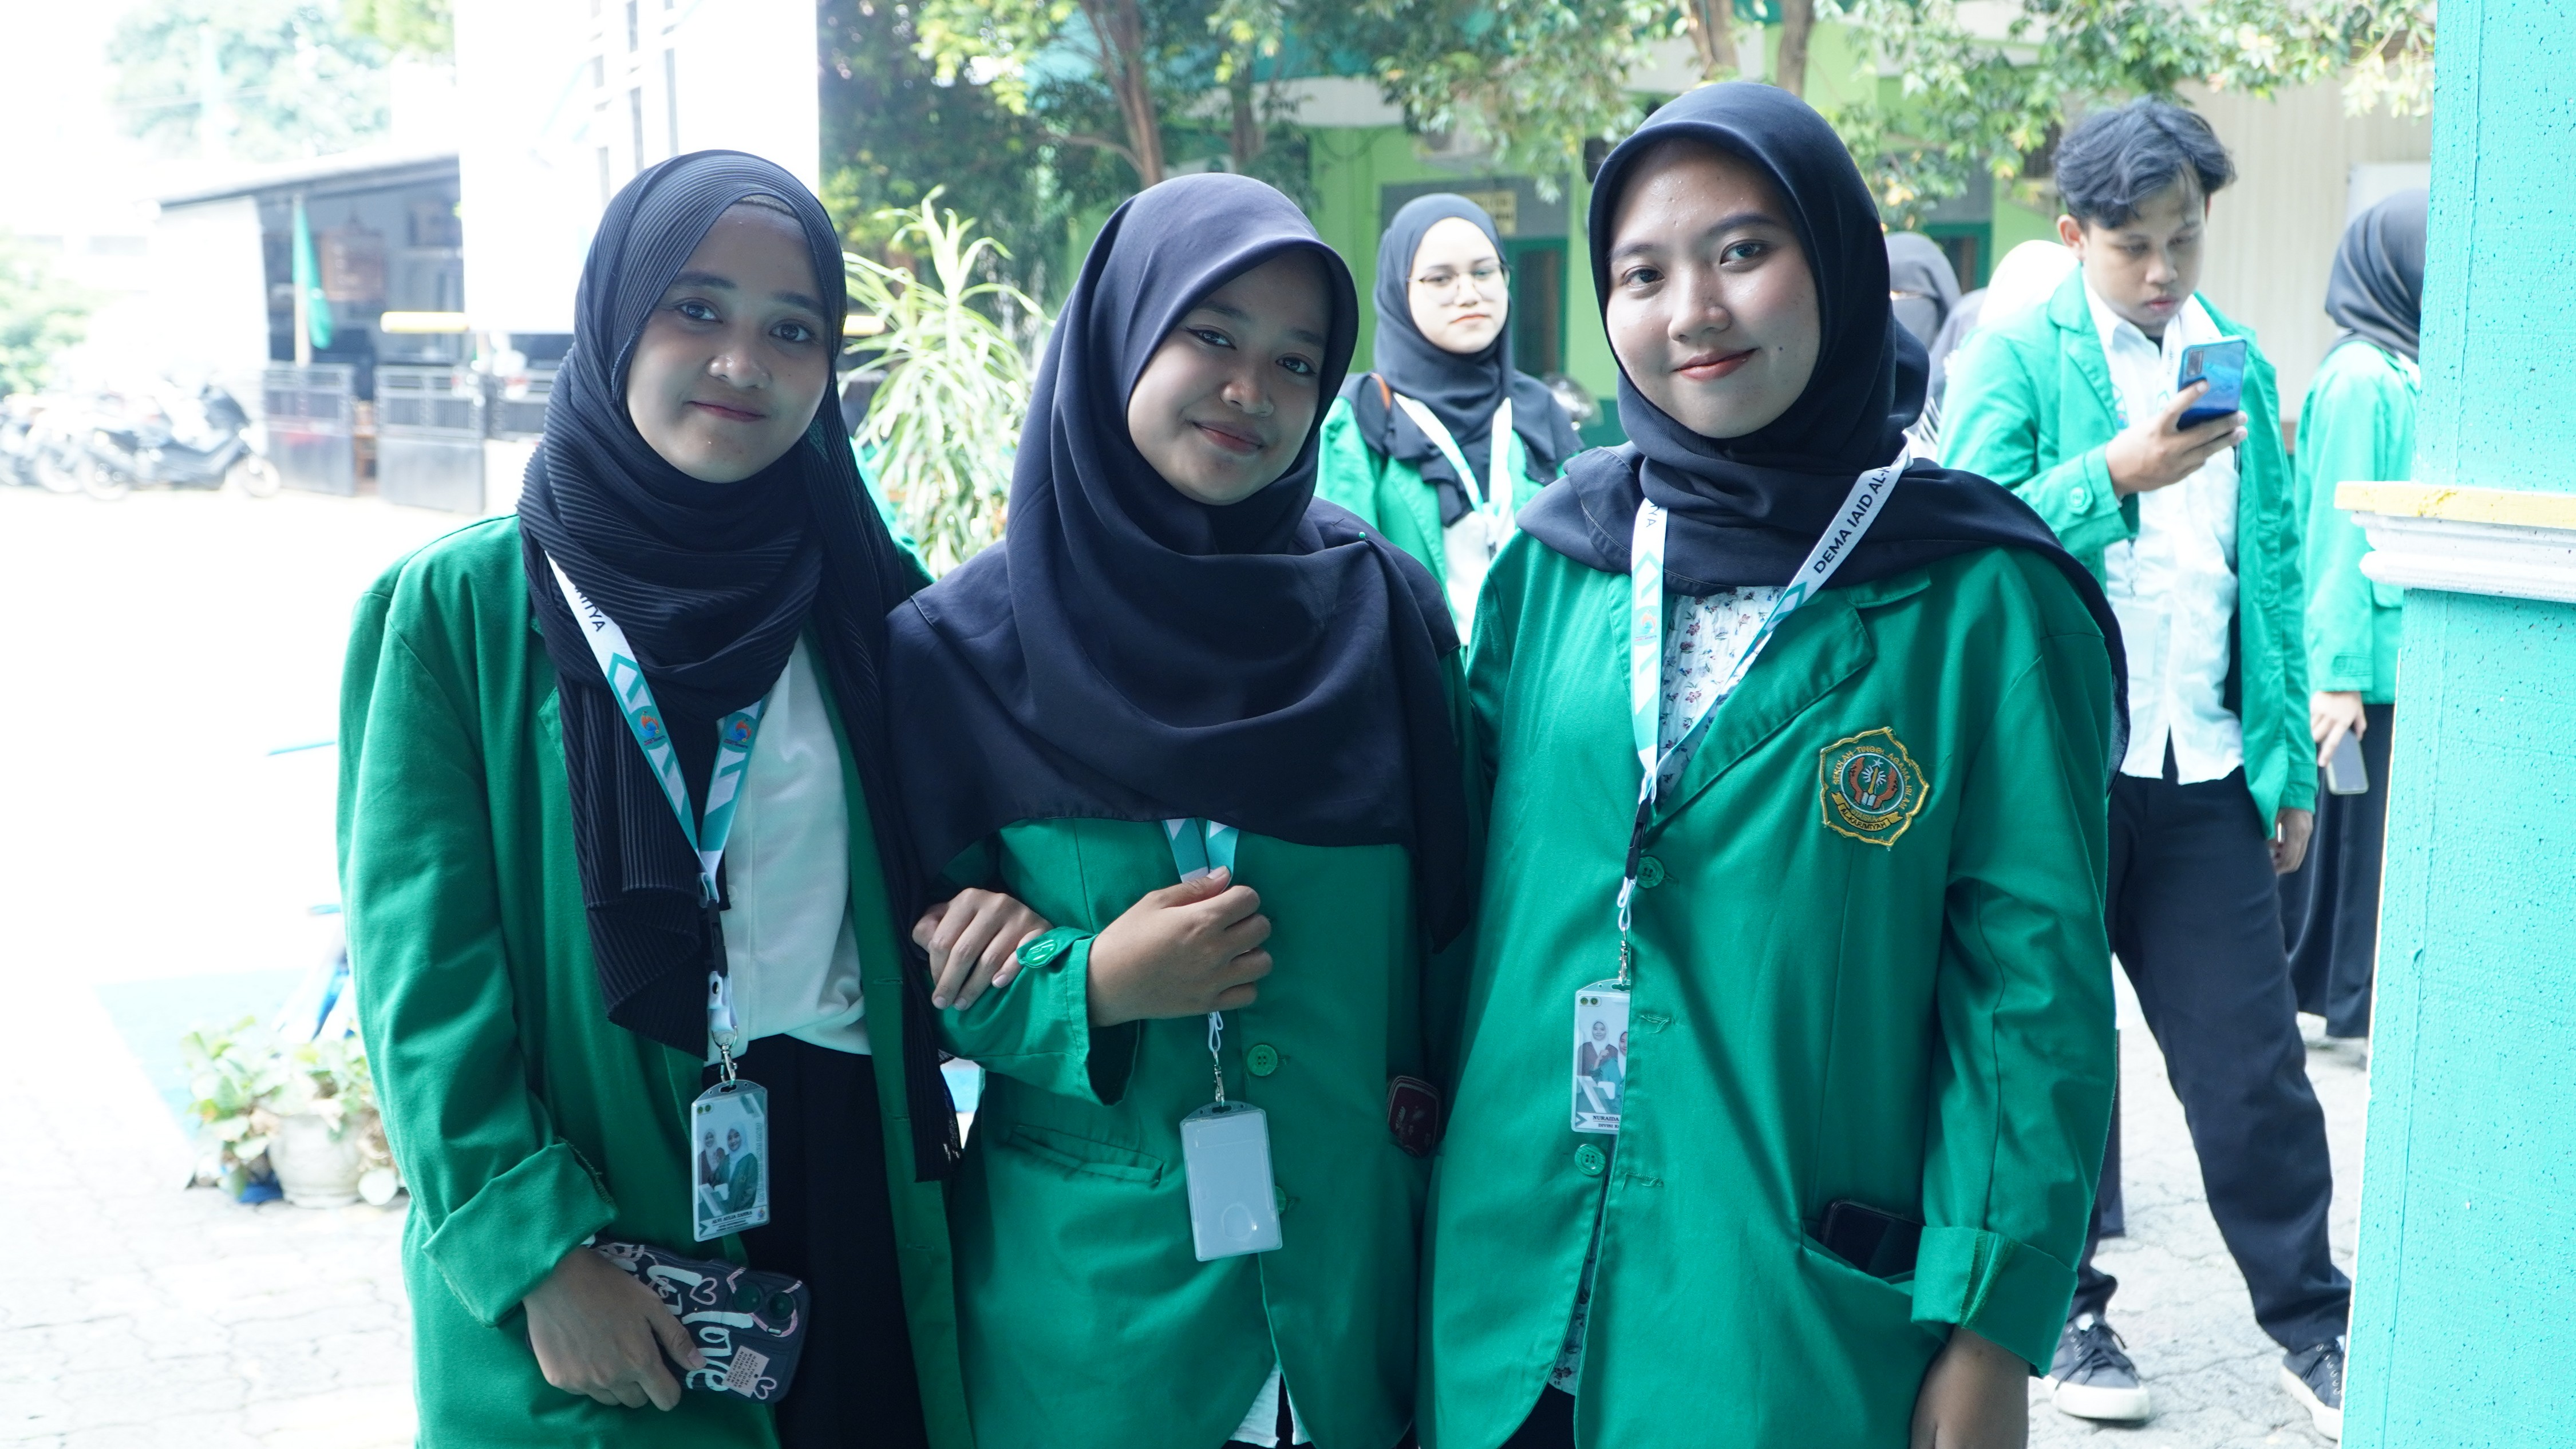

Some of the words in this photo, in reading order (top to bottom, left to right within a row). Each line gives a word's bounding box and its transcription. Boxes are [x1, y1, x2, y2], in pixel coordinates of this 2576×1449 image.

[1814, 529, 1852, 574] DEMA
[1847, 494, 1873, 528] IAID
[1856, 746, 1884, 754] TINGGI
[1833, 751, 1854, 785] SEKOLAH
[1888, 753, 1911, 785] AGAMA
[1899, 785, 1912, 810] ISLAM
[747, 1355, 756, 1371] HAPPY
